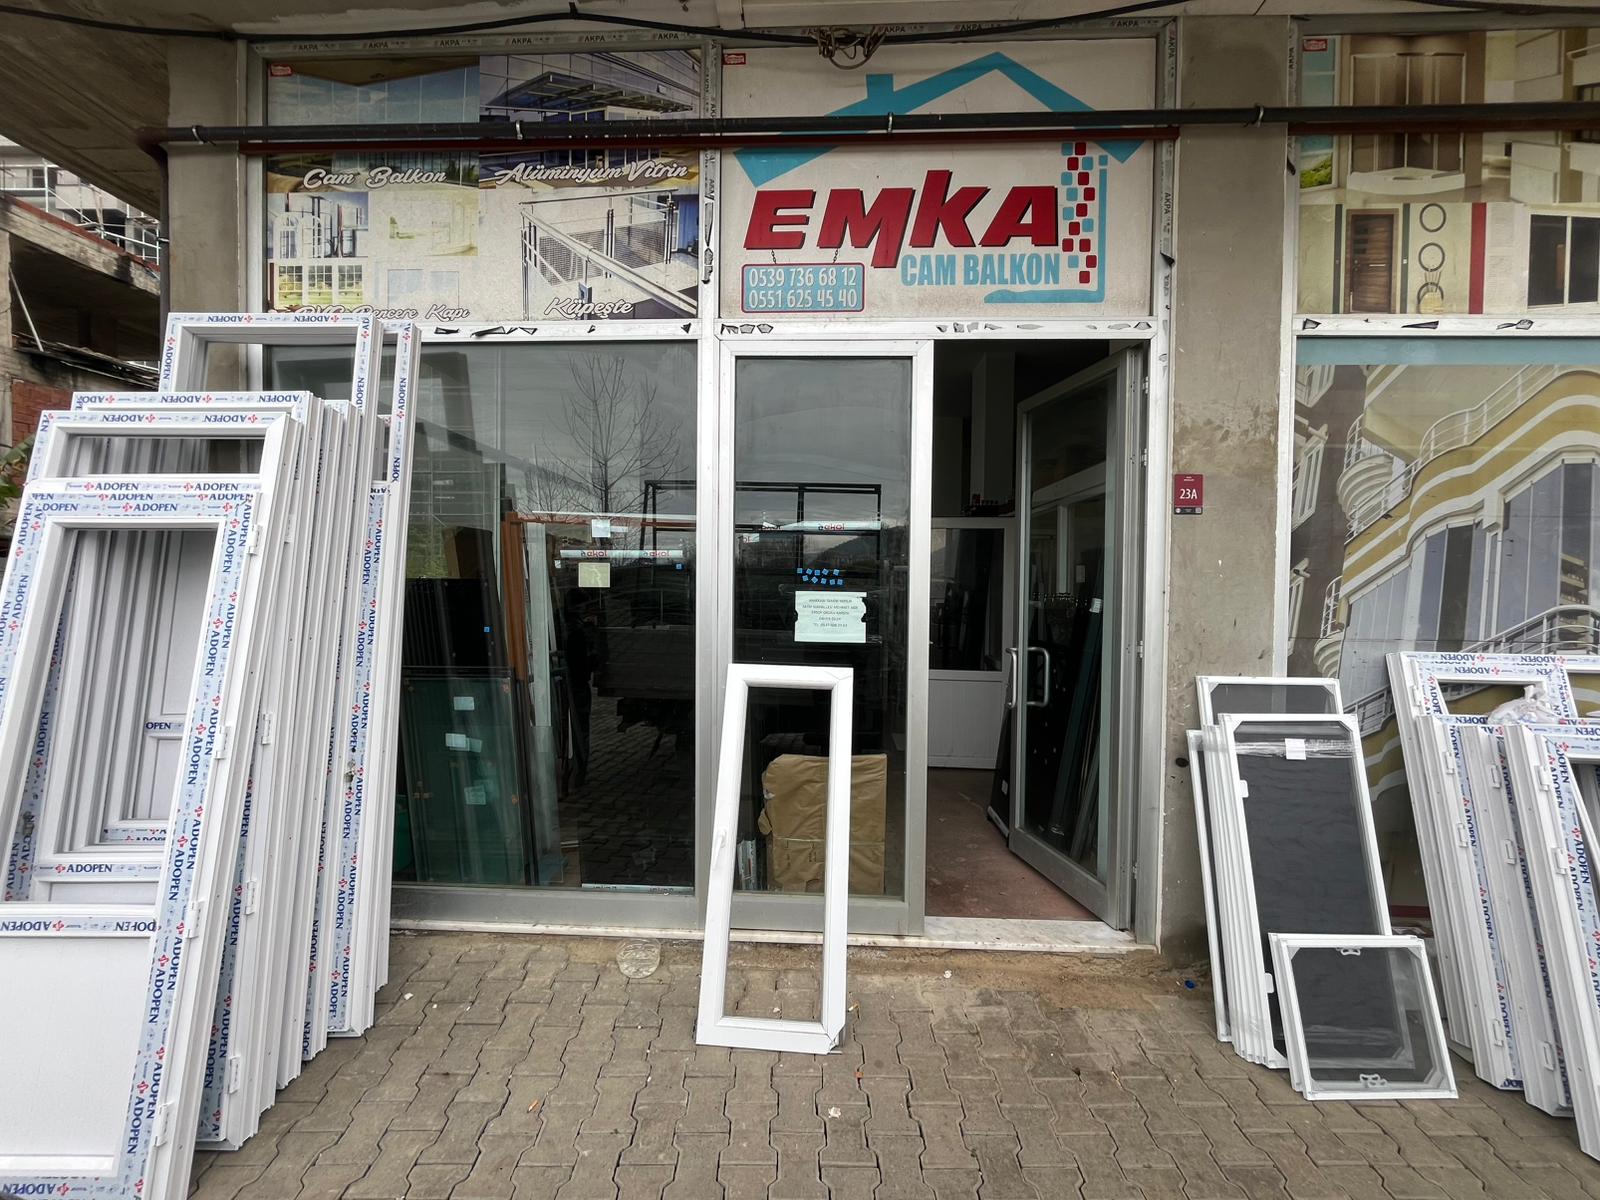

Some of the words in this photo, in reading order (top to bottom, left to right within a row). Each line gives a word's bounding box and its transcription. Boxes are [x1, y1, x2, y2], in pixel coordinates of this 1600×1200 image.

[439, 38, 460, 46] AKPA
[511, 36, 532, 45] AKPA
[1116, 20, 1139, 28] AKPA
[303, 168, 355, 189] Cam
[365, 166, 447, 188] Balkon
[494, 162, 623, 185] Alüminyum
[624, 160, 688, 182] Vitrin
[743, 170, 1059, 269] EMKA
[1163, 192, 1171, 214] AKPA
[749, 268, 785, 287] 0539
[789, 268, 814, 287] 736
[818, 267, 837, 286] 68
[841, 267, 857, 286] 12
[901, 254, 957, 287] CAM
[963, 253, 1060, 285] BALKON
[425, 303, 471, 321] Kapı
[544, 297, 633, 319] Küpeşte
[749, 290, 782, 308] 0551
[787, 289, 813, 308] 625
[817, 289, 834, 308] 45
[839, 289, 858, 307] 40
[207, 315, 244, 323] ADOPEN
[294, 315, 331, 323] ADOPEN
[163, 345, 174, 381] ADOPEN
[160, 395, 202, 404] ADOPEN
[259, 394, 300, 403] ADOPEN
[398, 378, 407, 411] ADOPEN
[102, 413, 144, 422] ADOPEN
[204, 414, 247, 423] ADOPEN
[94, 482, 139, 491] ADOPEN
[194, 483, 239, 491] ADOPEN
[1180, 488, 1198, 500] 23A
[17, 503, 34, 546] ADOPEN
[133, 503, 178, 512] ADOPEN
[239, 503, 252, 547] ADOPEN
[222, 529, 238, 573] ADOPEN
[362, 549, 372, 585] ADOPEN
[12, 575, 29, 620] ADOPEN
[222, 604, 236, 649] ADOPEN
[205, 630, 220, 676] ADOPEN
[355, 631, 365, 667] ADOPEN
[1441, 653, 1476, 662] ADOPEN
[1520, 655, 1557, 663] ADOPEN
[37, 711, 49, 756] ADOPEN
[204, 708, 219, 756] ADOPEN
[188, 735, 203, 785] ADOPEN
[240, 791, 252, 837] ADOPEN
[354, 777, 364, 816] ADOPEN
[343, 801, 352, 839] ADOPEN
[187, 819, 201, 870] ADOPEN
[1575, 839, 1591, 884] ADOPEN
[7, 843, 20, 890] ADOPEN
[67, 863, 113, 873] ADOPEN
[169, 849, 185, 901] ADOPEN
[347, 866, 357, 905] ADOPEN
[0, 920, 52, 932] ADOPEN
[231, 897, 243, 946] ADOPEN
[335, 888, 346, 929] ADOPEN
[309, 920, 320, 961] ADOPEN
[167, 937, 182, 991] ADOPEN
[341, 957, 350, 998] ADOPEN
[149, 968, 166, 1024] ADOPEN
[219, 1008, 231, 1059] ADOPEN
[204, 1040, 218, 1089] ADOPEN
[147, 1062, 163, 1119] ADOPEN
[127, 1096, 146, 1155] ADOPEN
[3, 1183, 56, 1195] ADOPEN
